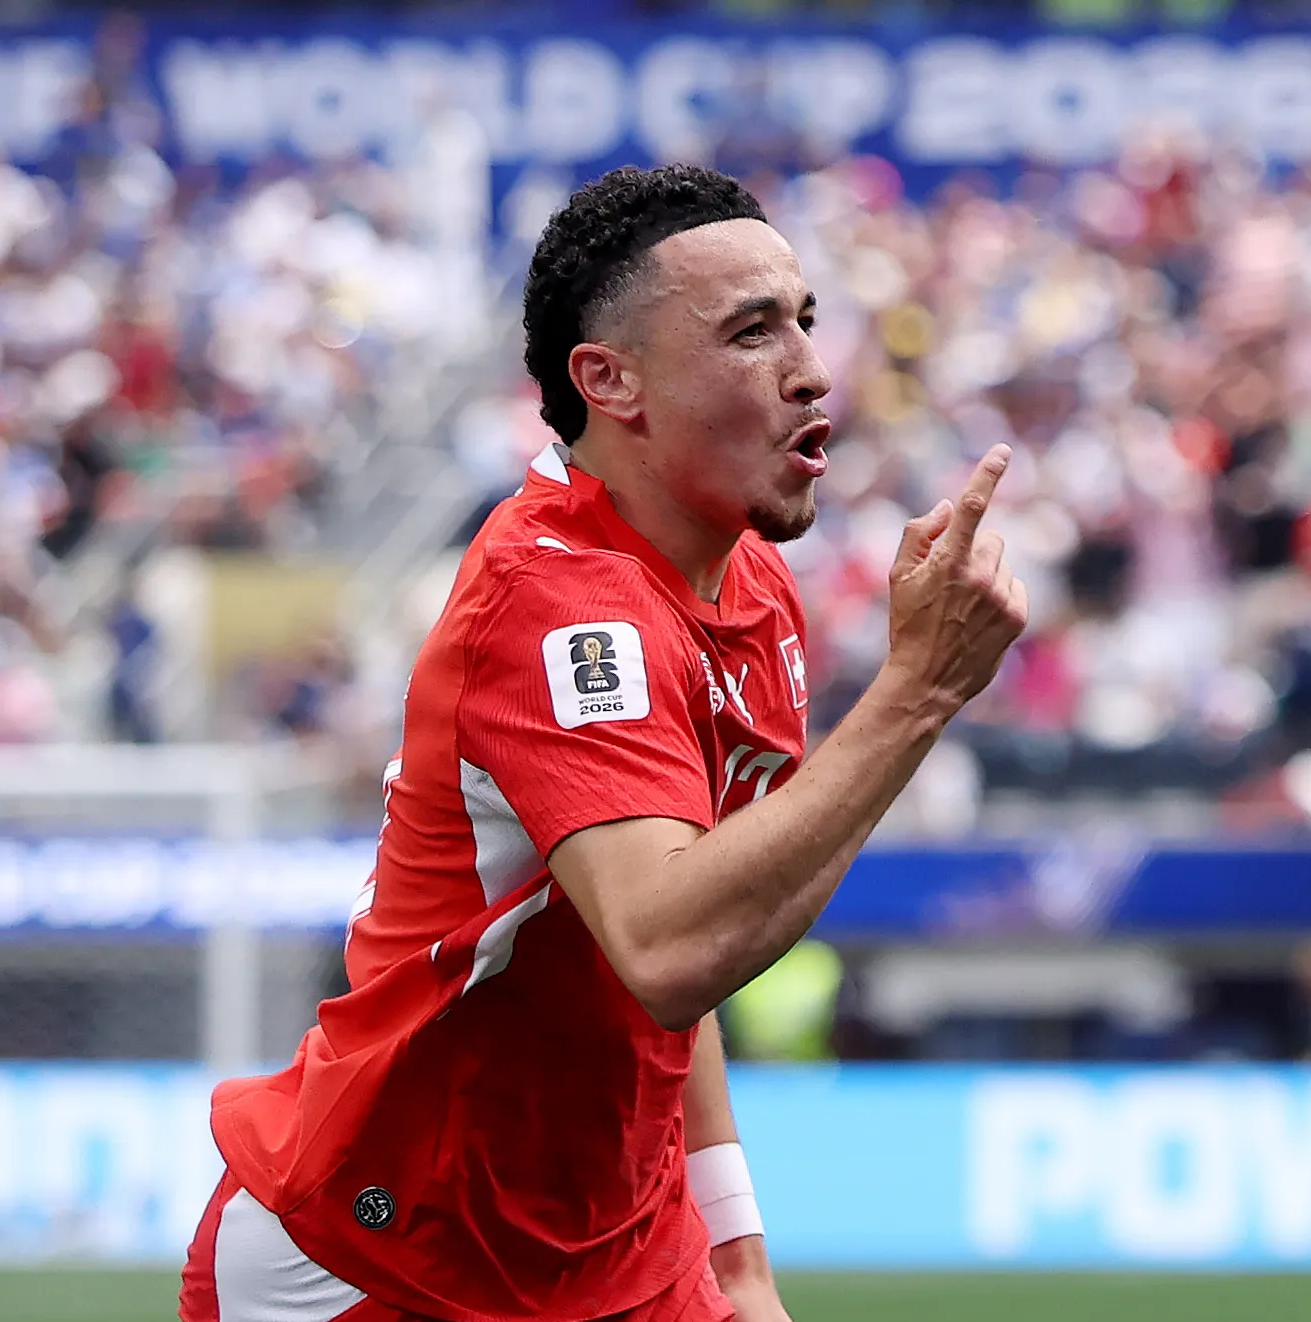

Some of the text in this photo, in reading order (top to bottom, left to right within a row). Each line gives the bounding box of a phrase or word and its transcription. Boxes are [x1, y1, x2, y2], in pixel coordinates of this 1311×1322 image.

[160, 38, 622, 164] WORLD
[586, 679, 610, 690] FIFA
[578, 694, 624, 706] WORLD CUP
[579, 702, 625, 716] 2026
